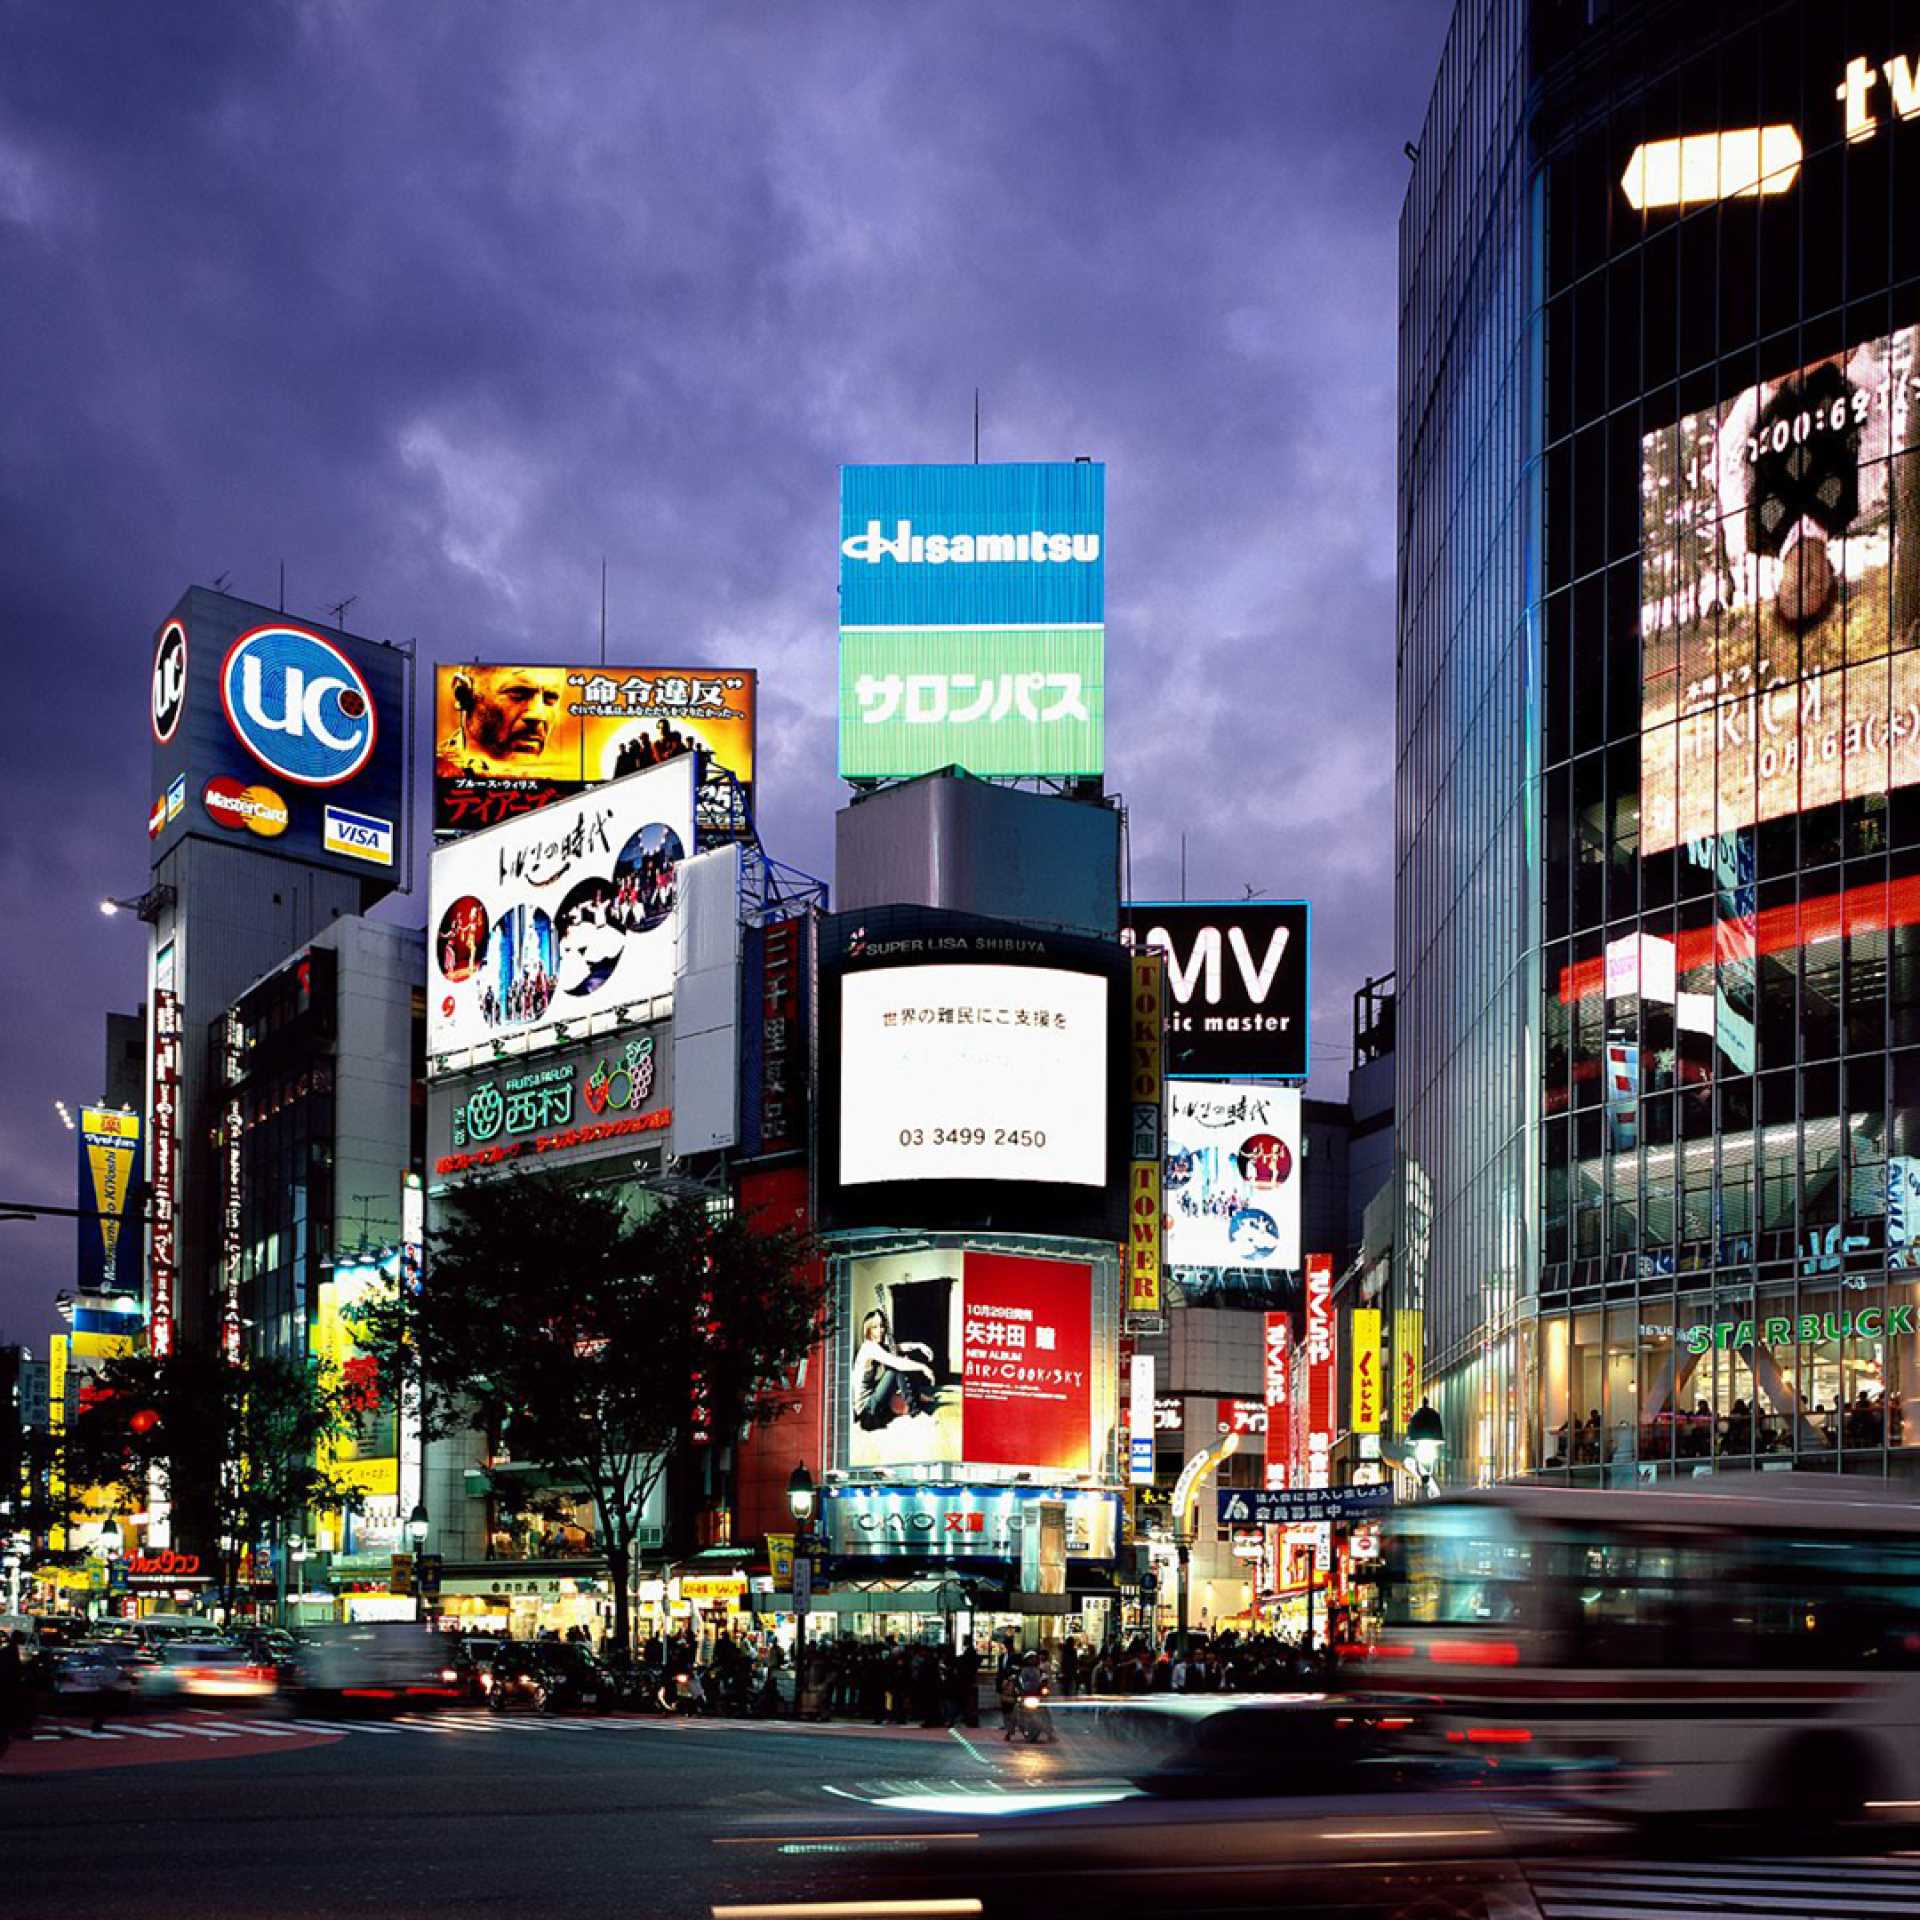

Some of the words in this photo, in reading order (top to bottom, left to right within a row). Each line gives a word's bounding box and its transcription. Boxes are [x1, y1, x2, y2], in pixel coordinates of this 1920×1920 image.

[842, 520, 1099, 563] Hisamitsu
[854, 672, 1088, 724] サロンパス
[206, 791, 288, 823] MasterCard
[338, 823, 379, 848] VISA
[866, 939, 923, 956] SUPER
[928, 937, 967, 950] LISA
[975, 937, 1046, 953] SHIBUYA
[1120, 926, 1290, 1005] MV
[1134, 966, 1157, 1096] TOKYO
[1204, 1013, 1290, 1032] master
[506, 1083, 573, 1134] 西村
[900, 1128, 924, 1147] 03
[933, 1127, 986, 1146] 3499
[994, 1128, 1047, 1148] 2450
[1132, 1168, 1156, 1297] TOWER
[966, 1320, 1025, 1347] 矢井田
[1687, 1303, 1920, 1354] STARBUCK
